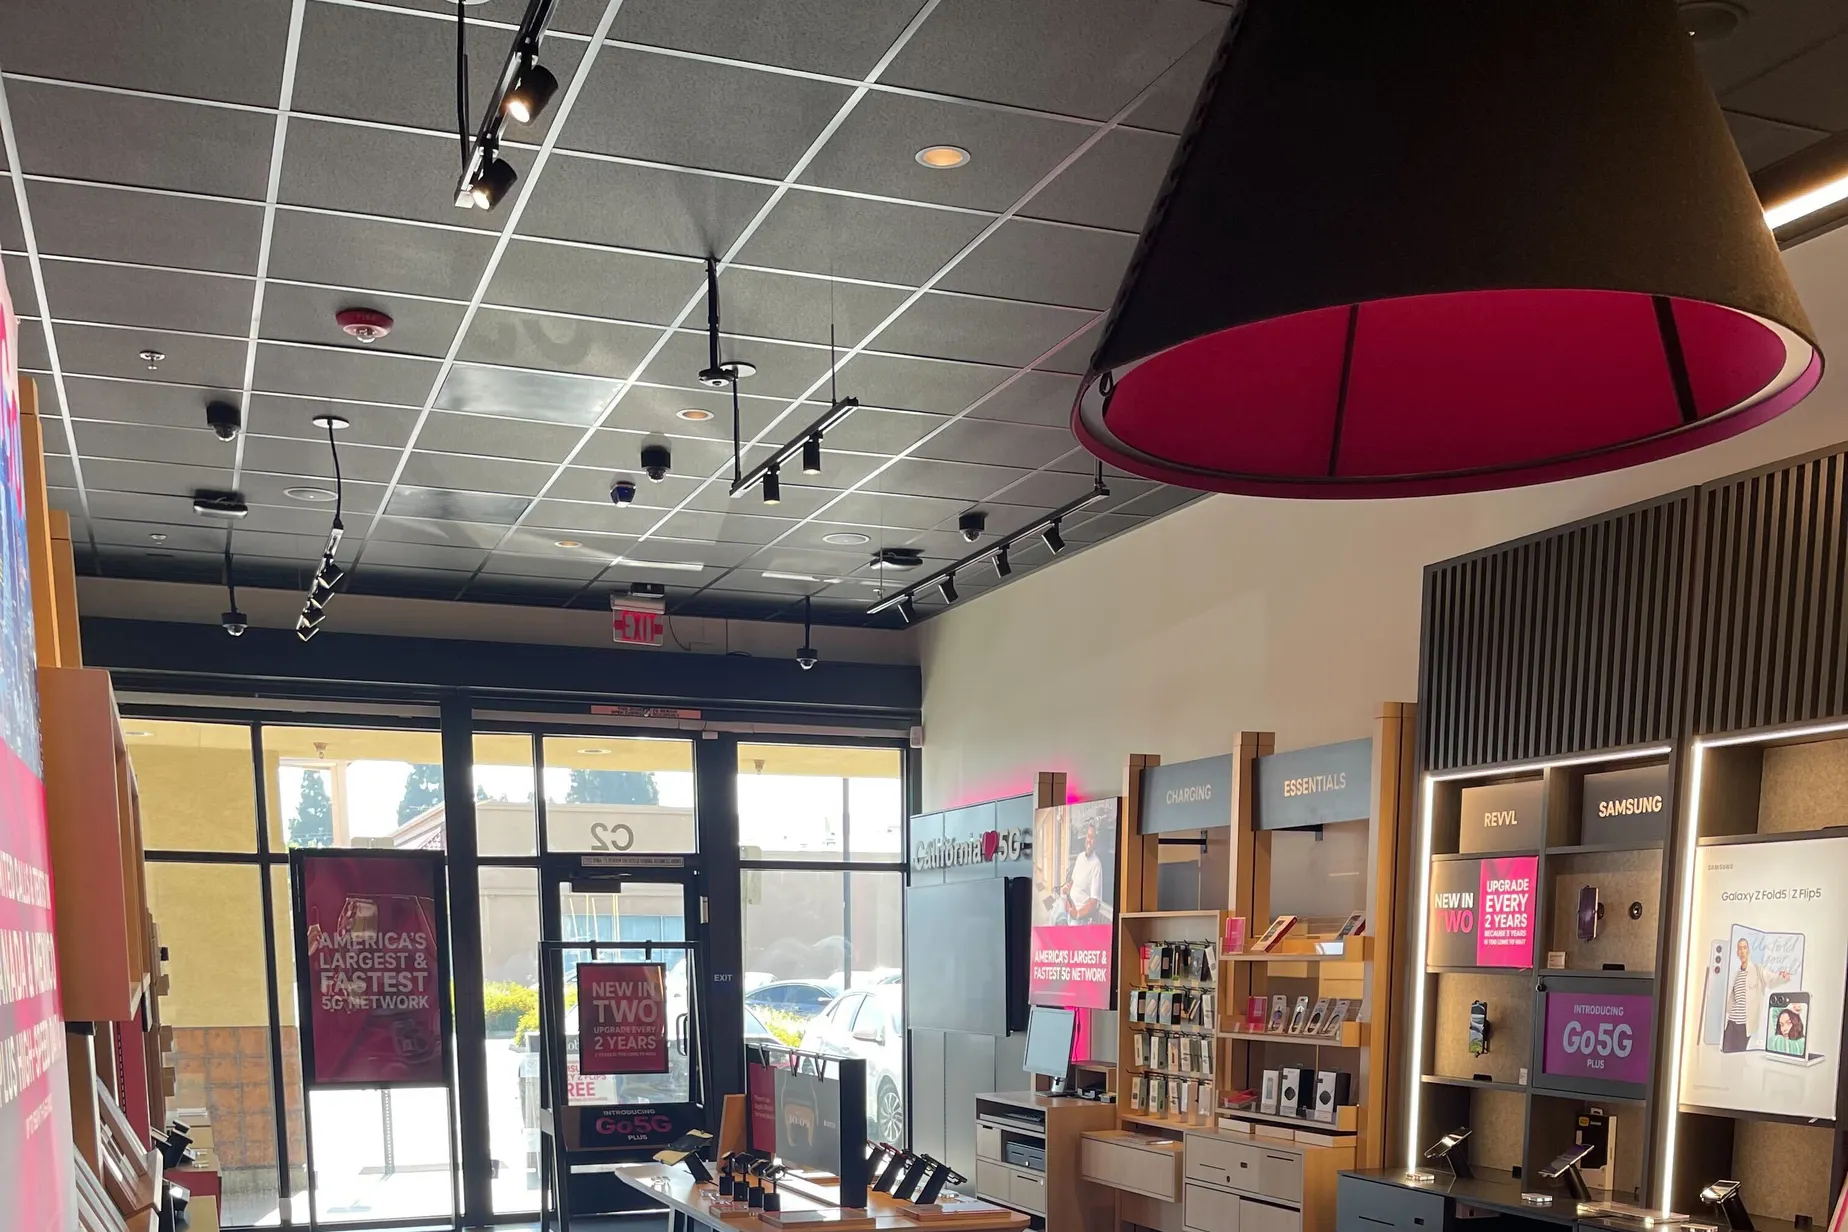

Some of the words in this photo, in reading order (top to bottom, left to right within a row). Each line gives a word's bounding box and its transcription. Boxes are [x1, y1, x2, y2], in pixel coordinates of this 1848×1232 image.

[622, 610, 657, 643] EXIT
[1284, 772, 1346, 797] ESSENTIALS
[1166, 784, 1212, 804] CHARGING
[1598, 795, 1663, 818] SAMSUNG
[1484, 810, 1518, 827] REVVL
[914, 836, 982, 871] California
[998, 827, 1021, 861] 5G
[1707, 863, 1734, 871] SAMSUNG
[1486, 879, 1529, 892] UPGRADE
[1434, 893, 1460, 908] NEW
[1461, 892, 1474, 908] IN
[1485, 894, 1528, 912] EVERY
[1721, 891, 1754, 903] Galaxy
[1755, 890, 1761, 900] Z
[1761, 889, 1787, 900] Fold5
[1791, 889, 1798, 899] Z
[1799, 887, 1821, 902] Flip5
[1436, 909, 1474, 933] TWO
[1484, 914, 1491, 928] 2
[1494, 913, 1528, 928] YEARS
[318, 932, 427, 949] AMERICA'S
[319, 952, 408, 969] LARGEST
[414, 952, 428, 969] &
[1034, 950, 1068, 964] AMERICA'S
[1069, 950, 1101, 964] LARGEST
[1101, 951, 1107, 965] &
[320, 971, 428, 993] FASTEST
[713, 974, 733, 982] EXIT
[1034, 966, 1061, 980] FASTEST
[1061, 967, 1071, 980] 5G
[1071, 968, 1106, 982] NETWORK
[592, 981, 634, 997] NEW
[638, 981, 655, 997] IN
[348, 995, 430, 1009] NETWORK
[1573, 1004, 1625, 1016] INTRODUCING
[592, 999, 658, 1023] TWO
[593, 1026, 630, 1034] UPGRADE
[631, 1025, 657, 1034] EVERY
[594, 1037, 604, 1050] 2
[607, 1035, 657, 1050] YEARS
[1563, 1020, 1633, 1058] Go5G
[1587, 1059, 1605, 1069] PLUS
[568, 1082, 595, 1097] REE
[603, 1108, 656, 1116] INTRODUCING
